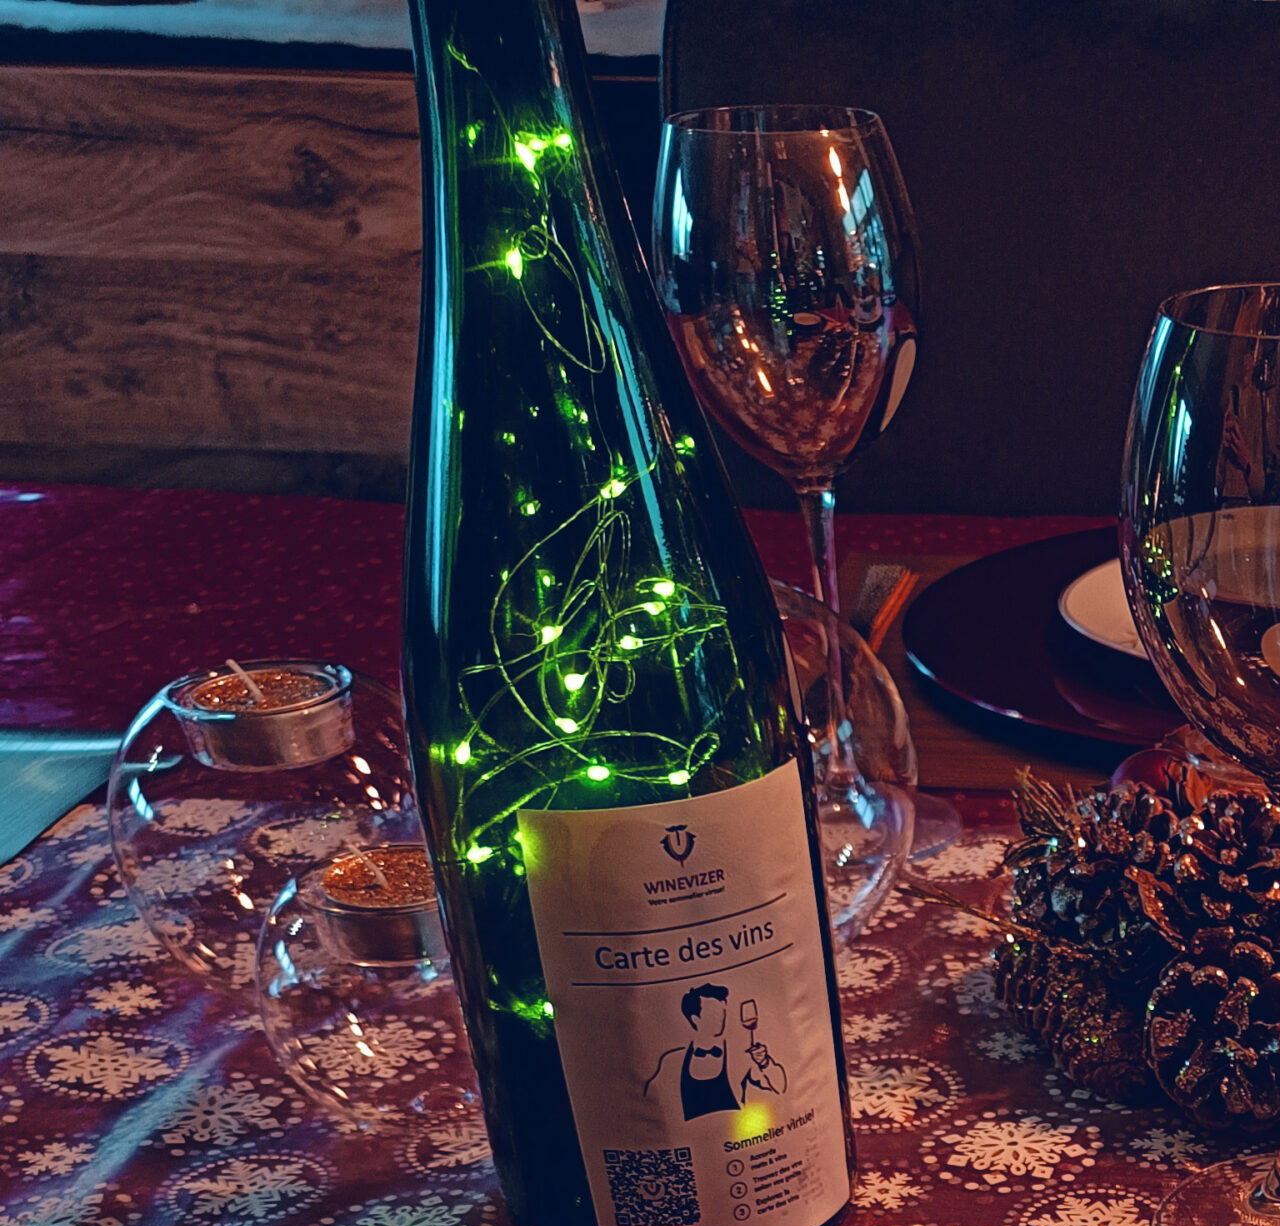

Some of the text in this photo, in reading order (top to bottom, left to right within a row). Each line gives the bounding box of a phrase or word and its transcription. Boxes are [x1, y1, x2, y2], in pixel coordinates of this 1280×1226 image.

[643, 868, 725, 895] WINEVIZER
[594, 921, 774, 970] Carte des vins
[724, 1107, 815, 1152] Sommelier virtuel
